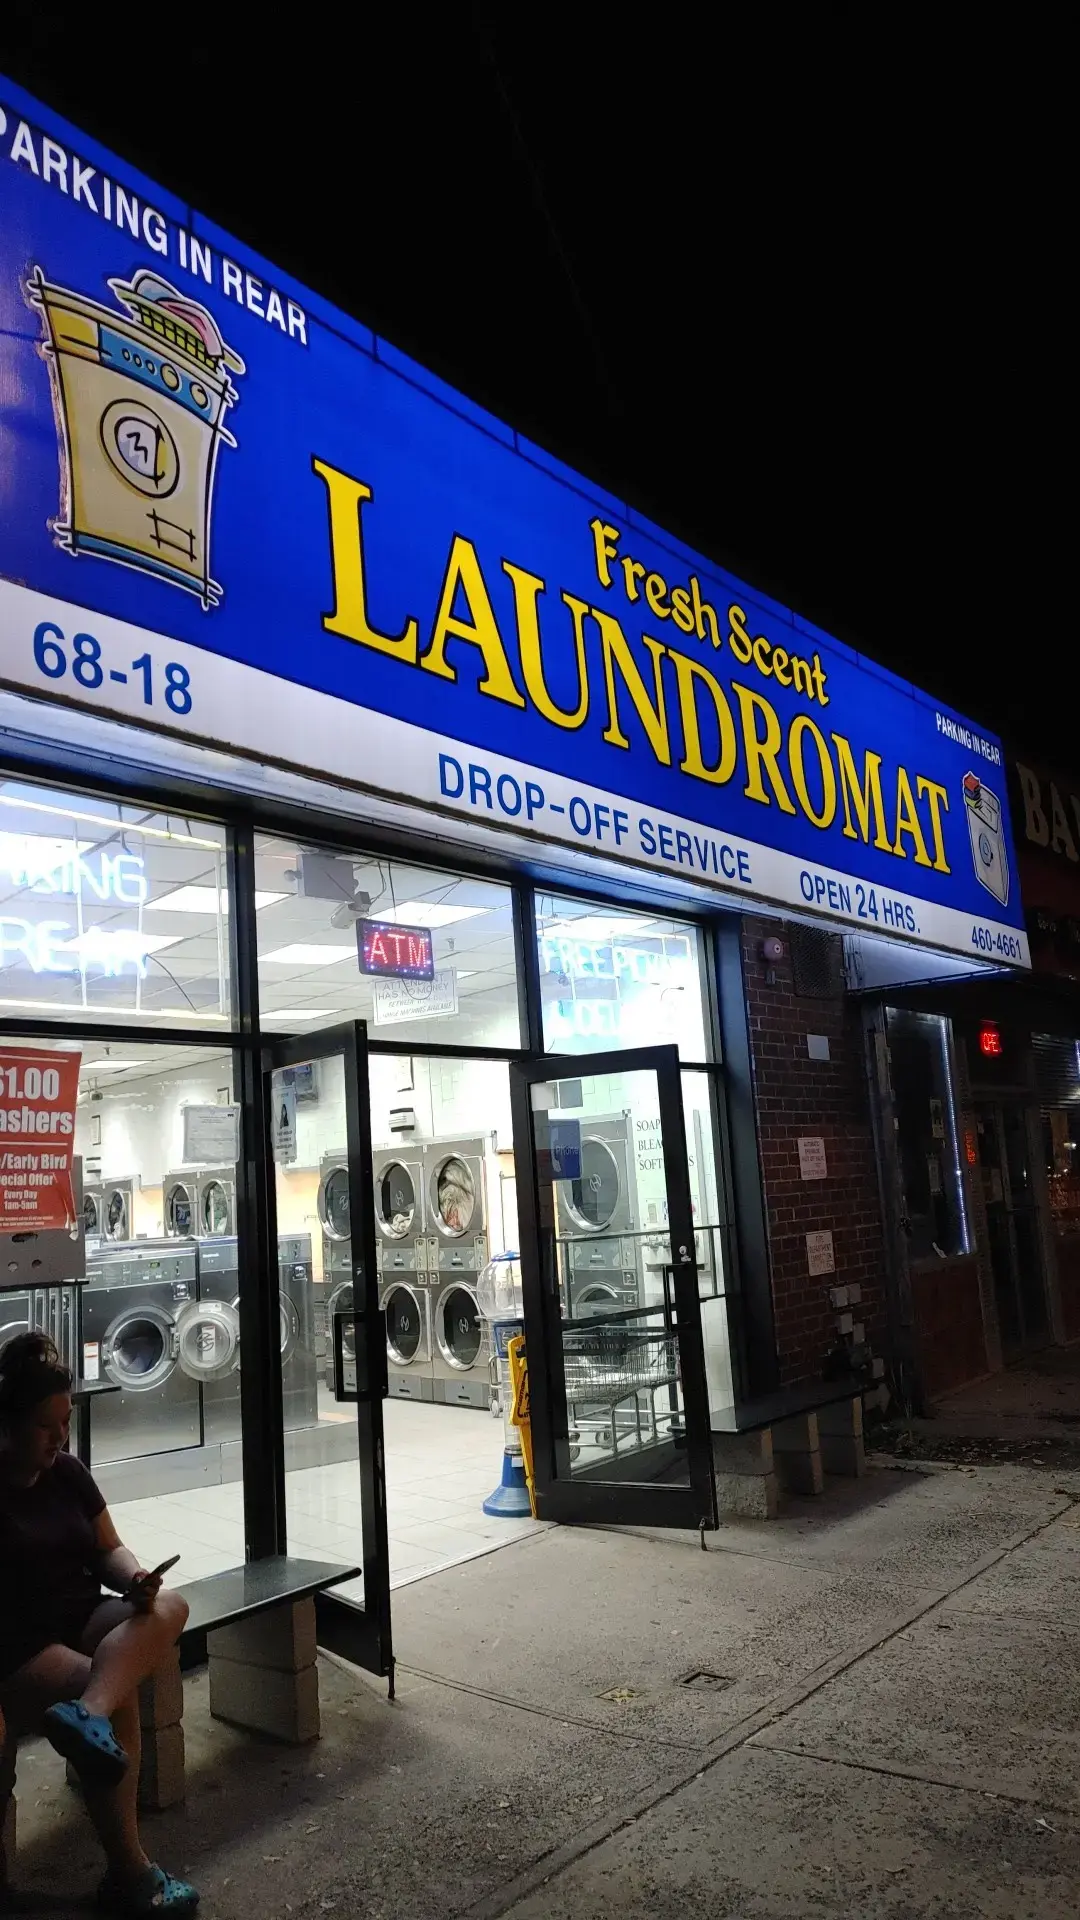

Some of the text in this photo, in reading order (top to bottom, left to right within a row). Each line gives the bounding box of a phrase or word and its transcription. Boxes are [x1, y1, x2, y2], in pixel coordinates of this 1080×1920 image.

[0, 106, 307, 345] ARKING IN REAR
[590, 517, 830, 705] Fresh Scent
[33, 622, 192, 715] 68-18
[311, 455, 952, 875] LAUNDROMAT
[936, 711, 1000, 766] PARKING IN REAR
[438, 753, 752, 884] DROP-OFF SERVICE
[800, 870, 921, 934] OPEN 24 HRS.
[370, 931, 427, 968] ATM
[971, 925, 1022, 960] 460-4661
[29, 1173, 54, 1186] Offer
[41, 1153, 67, 1169] Bird
